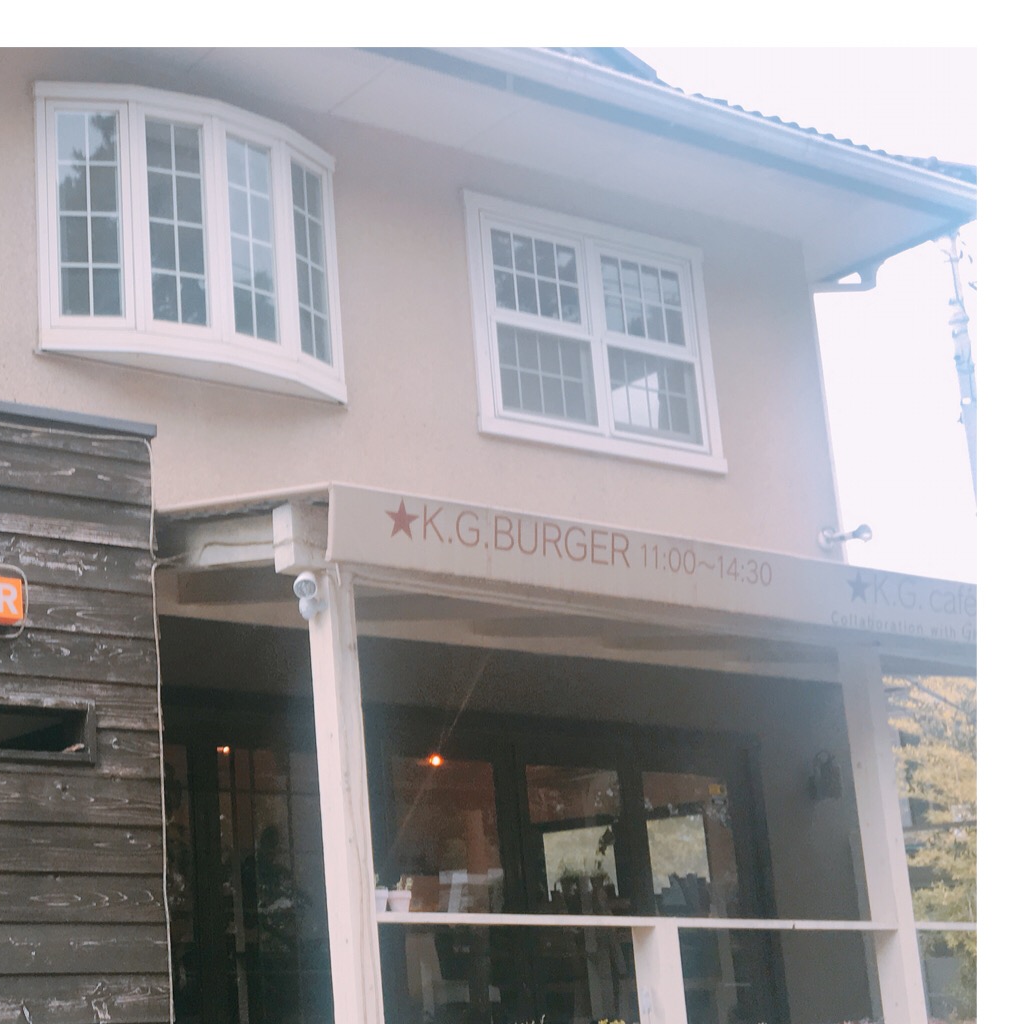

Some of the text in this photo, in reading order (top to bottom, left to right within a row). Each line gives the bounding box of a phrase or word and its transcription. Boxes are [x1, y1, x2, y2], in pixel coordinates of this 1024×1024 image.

[423, 503, 630, 568] K.G.BURGER
[873, 574, 977, 617] K.G. café
[831, 610, 924, 635] Collaboration
[930, 623, 956, 639] with
